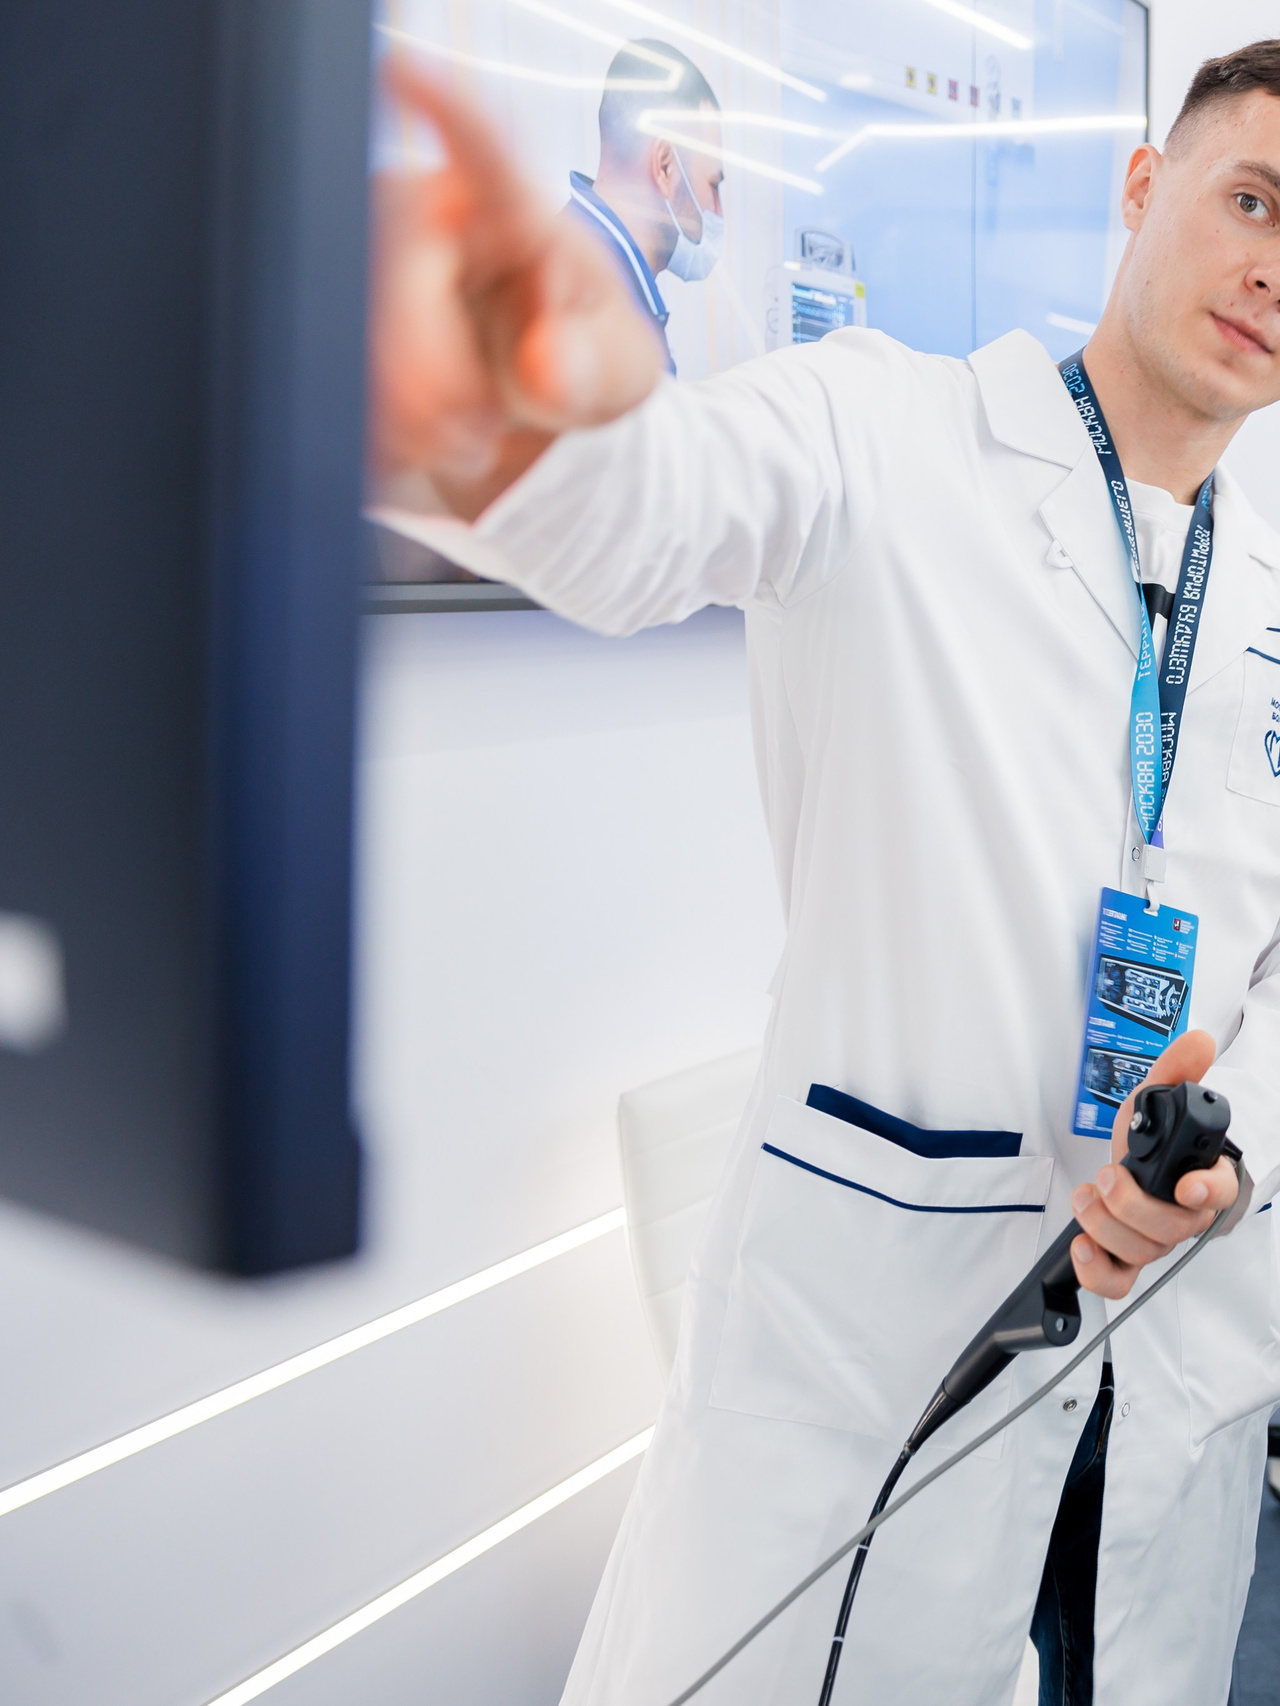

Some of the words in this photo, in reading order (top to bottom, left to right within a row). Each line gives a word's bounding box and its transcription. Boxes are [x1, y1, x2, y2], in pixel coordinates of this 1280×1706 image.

[1061, 362, 1086, 396] 2030
[1074, 396, 1112, 455] МОСКВА
[1182, 524, 1211, 600] ТЕРРИТОРИЯ
[1166, 603, 1198, 685] БУДУЩЕГО
[1135, 711, 1154, 756] 2030
[1136, 761, 1155, 832] МОСКВА
